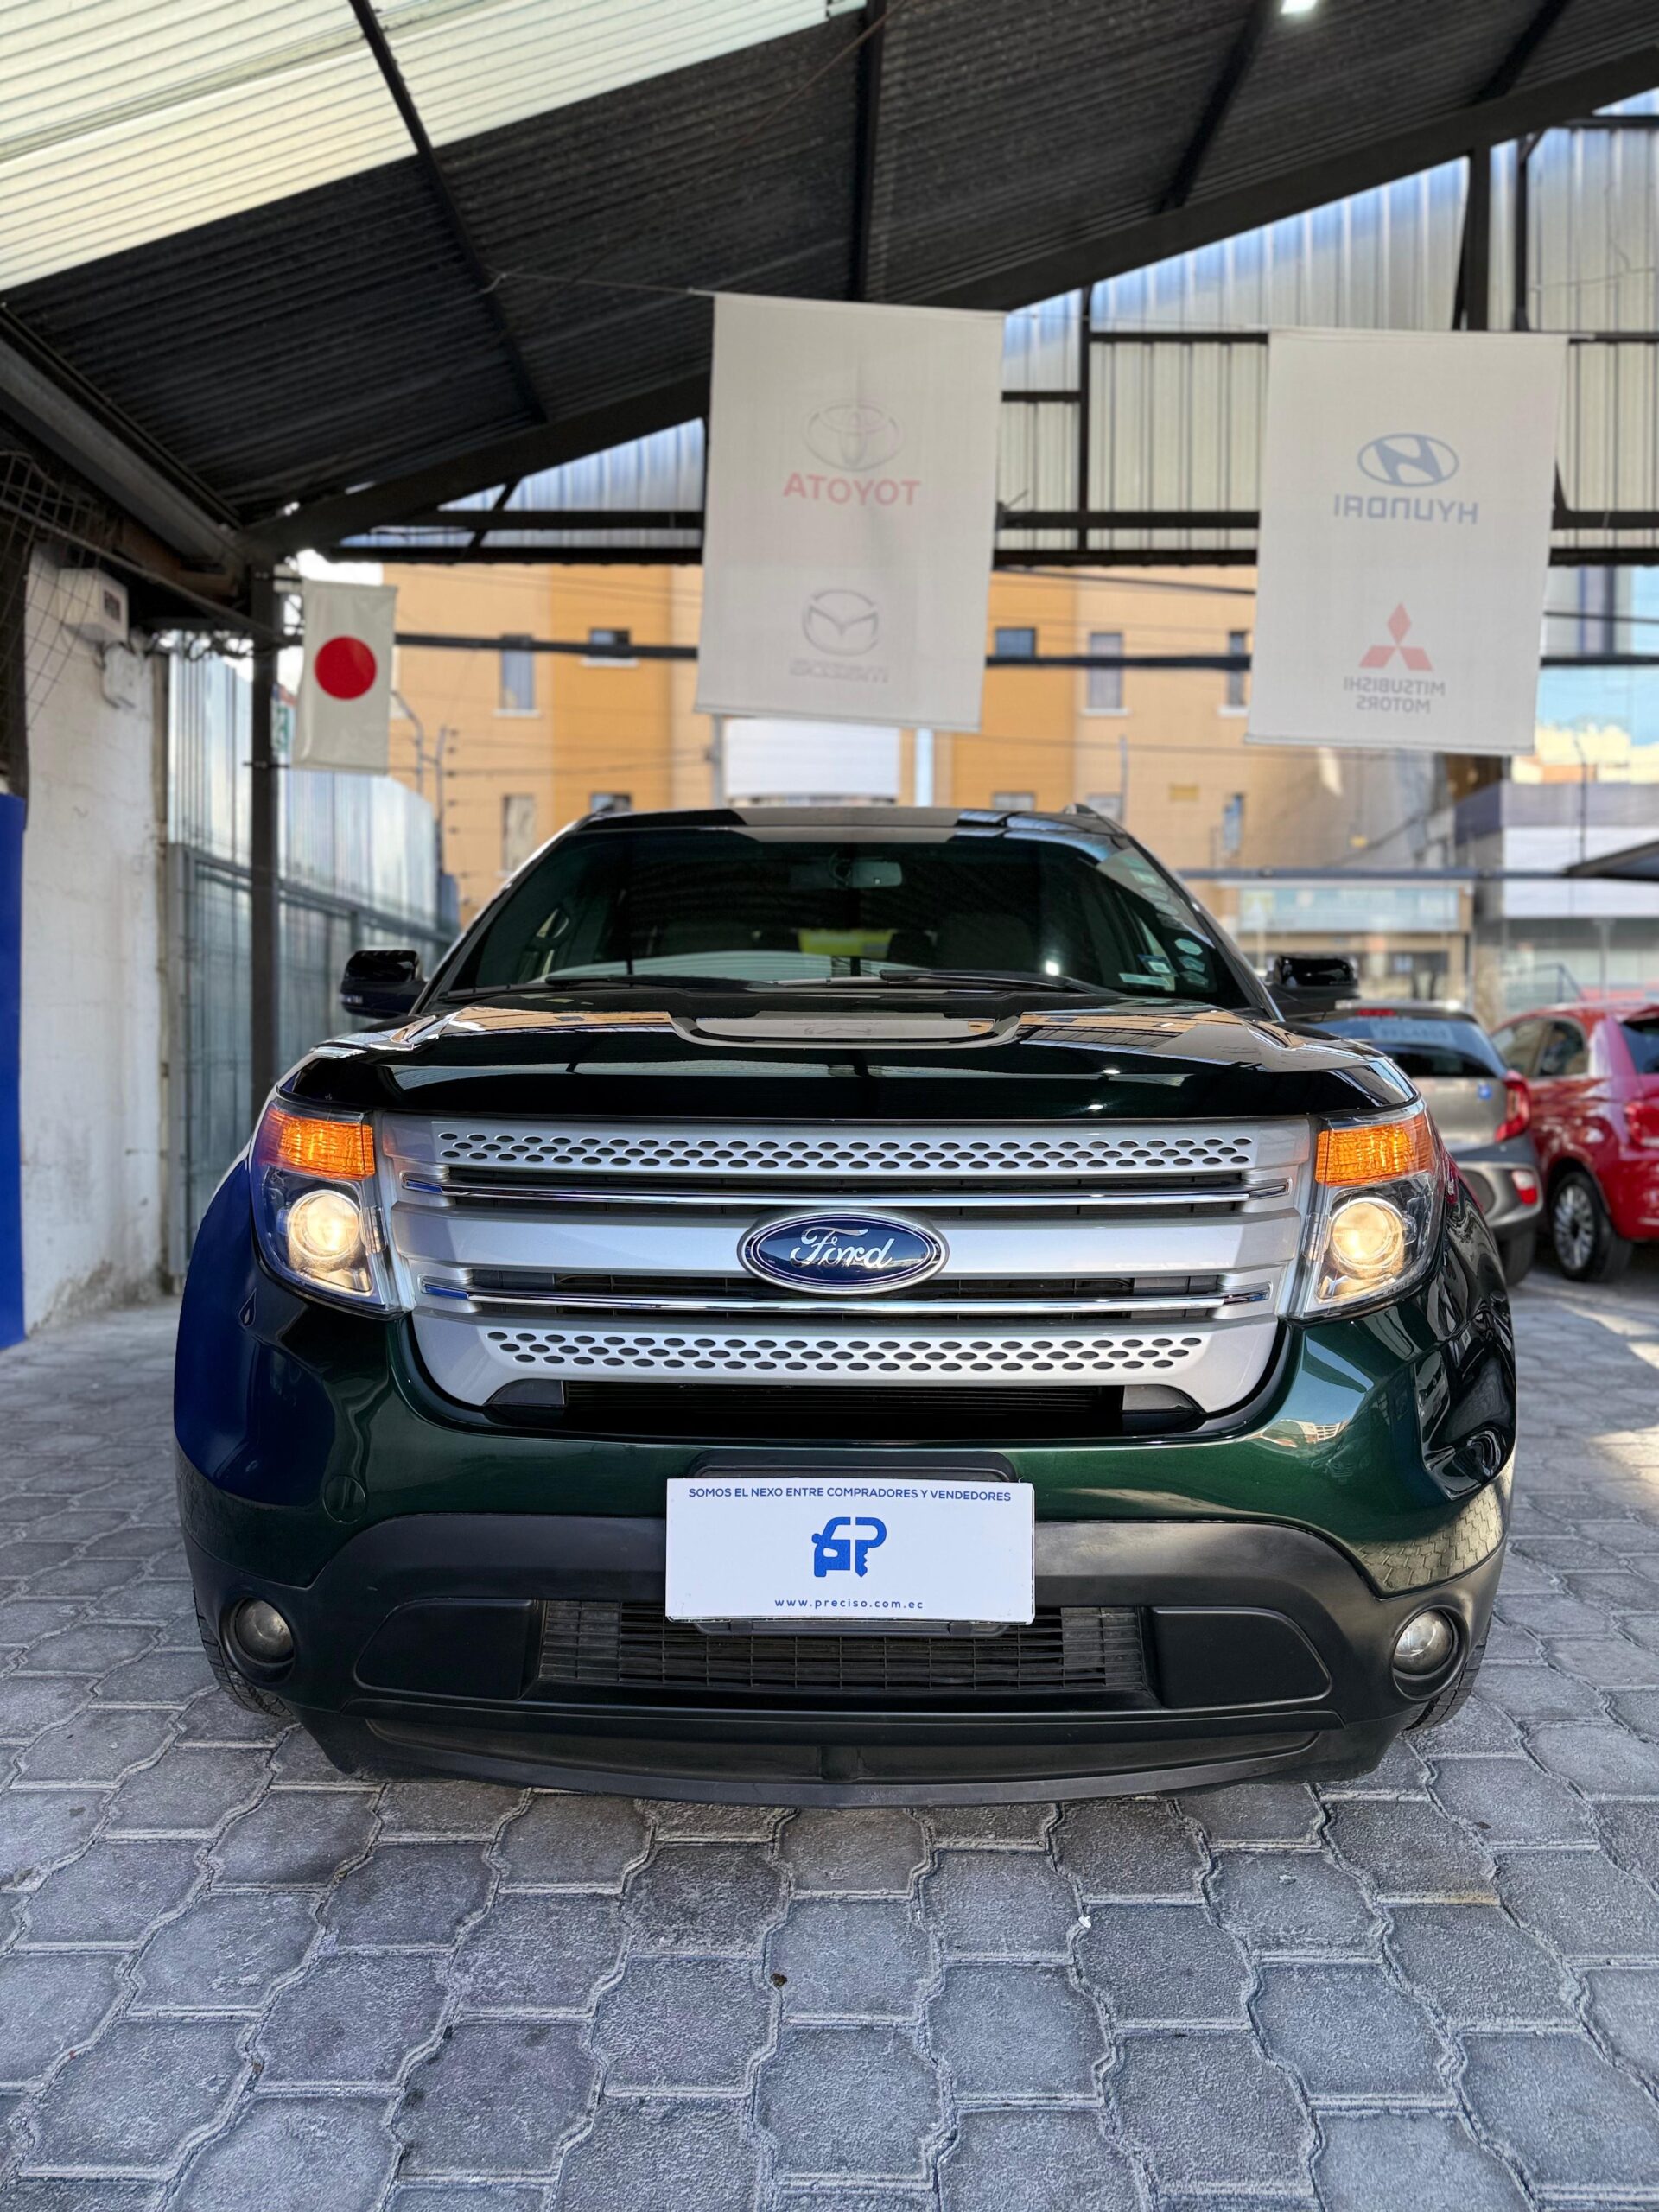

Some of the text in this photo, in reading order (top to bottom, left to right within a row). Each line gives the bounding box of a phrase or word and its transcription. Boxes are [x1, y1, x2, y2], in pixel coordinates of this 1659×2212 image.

[790, 1225, 895, 1269] Ford
[688, 1487, 1012, 1502] SOMOS EL NEXO ENTRE COMPRADORES Y VENDEDORES
[774, 1599, 924, 1610] www.preciso.com.ec
